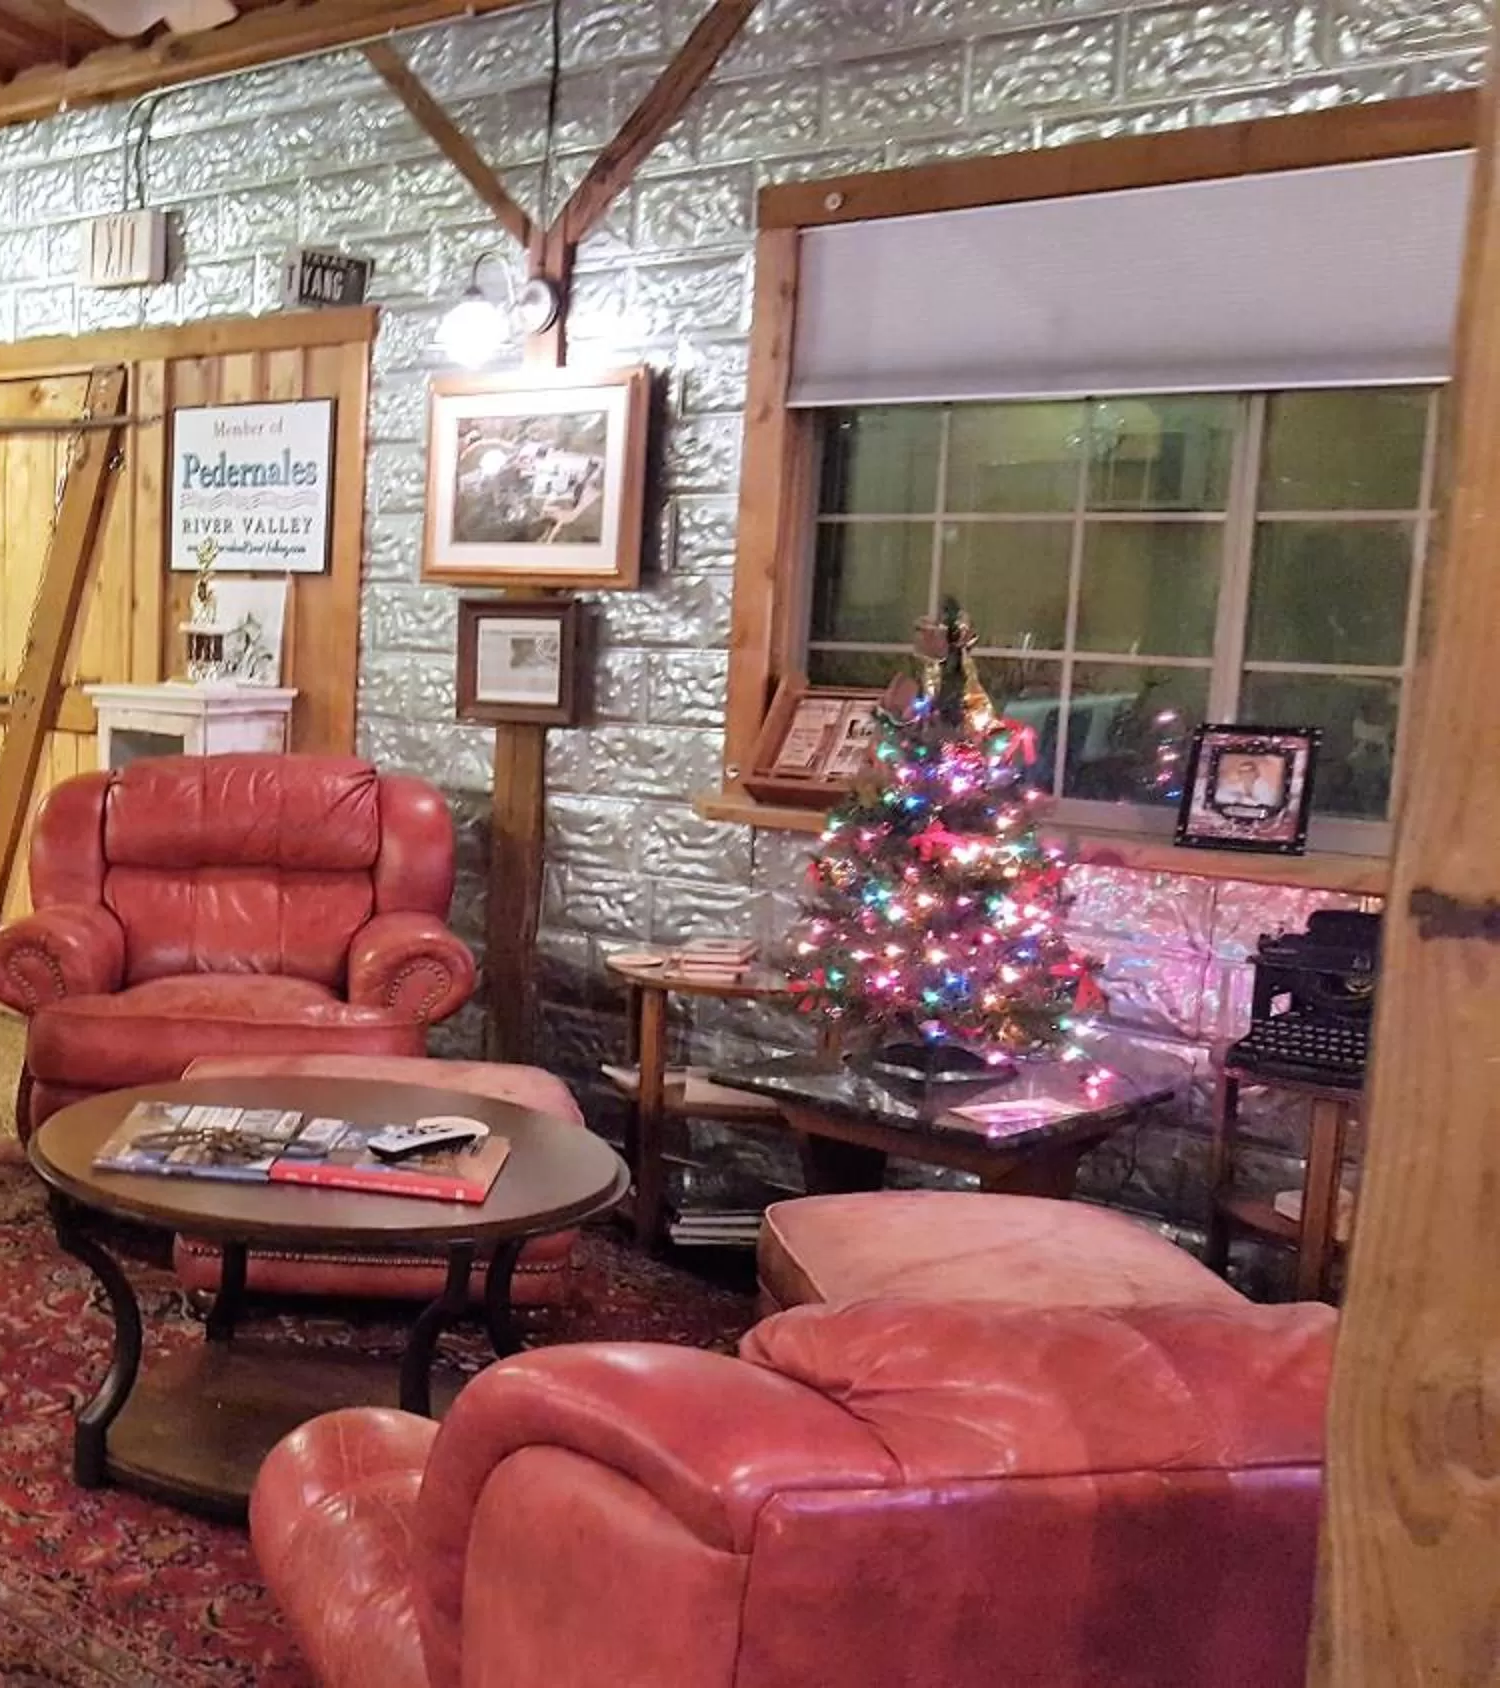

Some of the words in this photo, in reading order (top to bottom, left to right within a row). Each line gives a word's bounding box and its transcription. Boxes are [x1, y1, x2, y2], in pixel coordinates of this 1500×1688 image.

[213, 419, 264, 438] Member
[268, 416, 284, 434] of
[182, 444, 318, 490] Pedernales
[182, 516, 234, 535] RIVER
[242, 516, 314, 535] VALLEY
